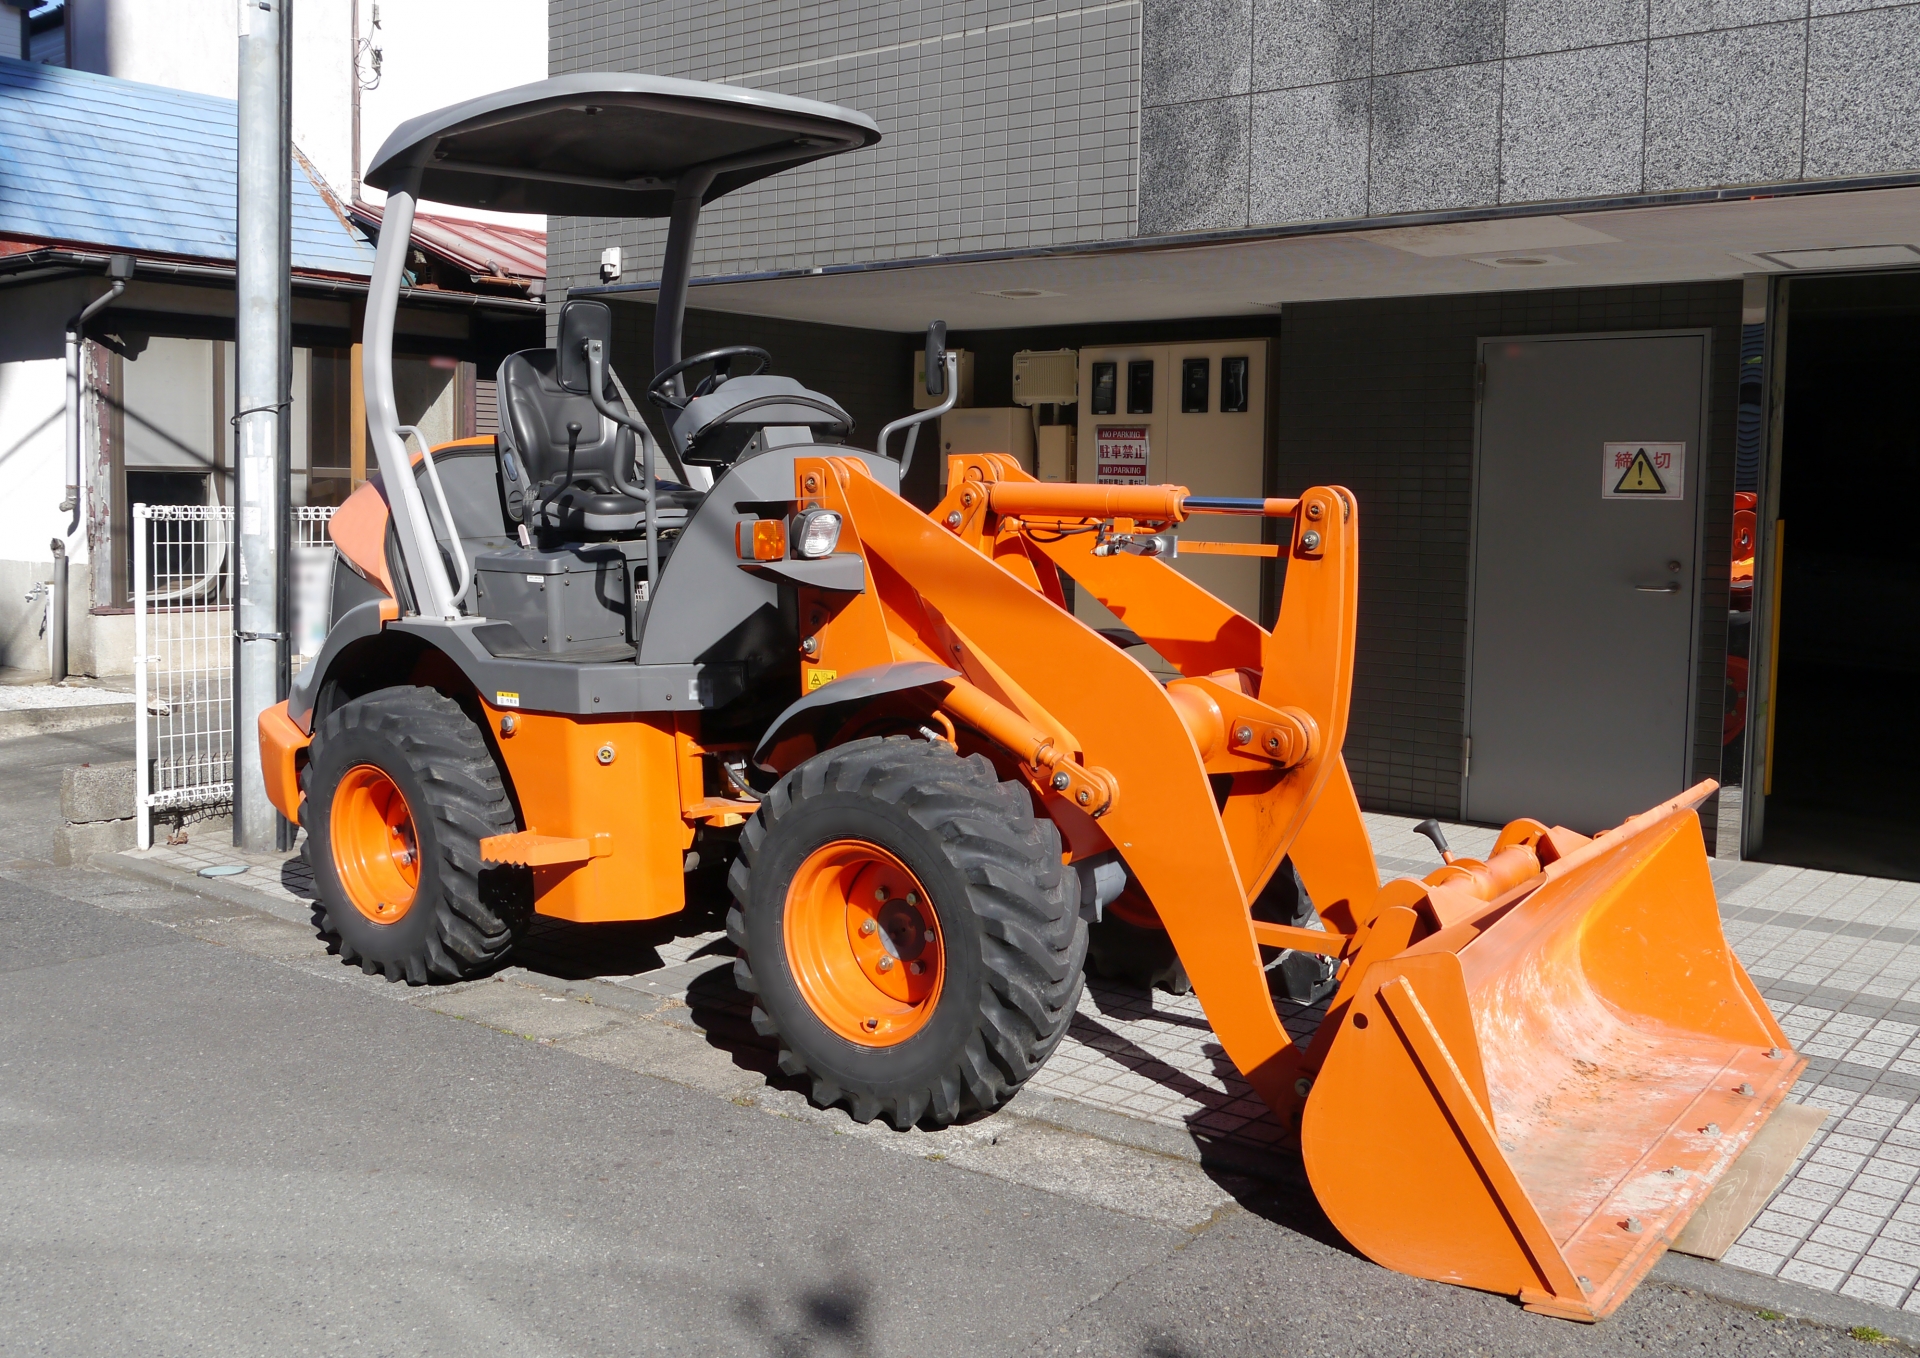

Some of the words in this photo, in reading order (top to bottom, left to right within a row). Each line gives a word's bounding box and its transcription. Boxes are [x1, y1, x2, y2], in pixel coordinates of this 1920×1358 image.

[1099, 444, 1145, 459] 駐車禁止
[1102, 466, 1113, 474] NO
[1113, 466, 1141, 474] PARKING
